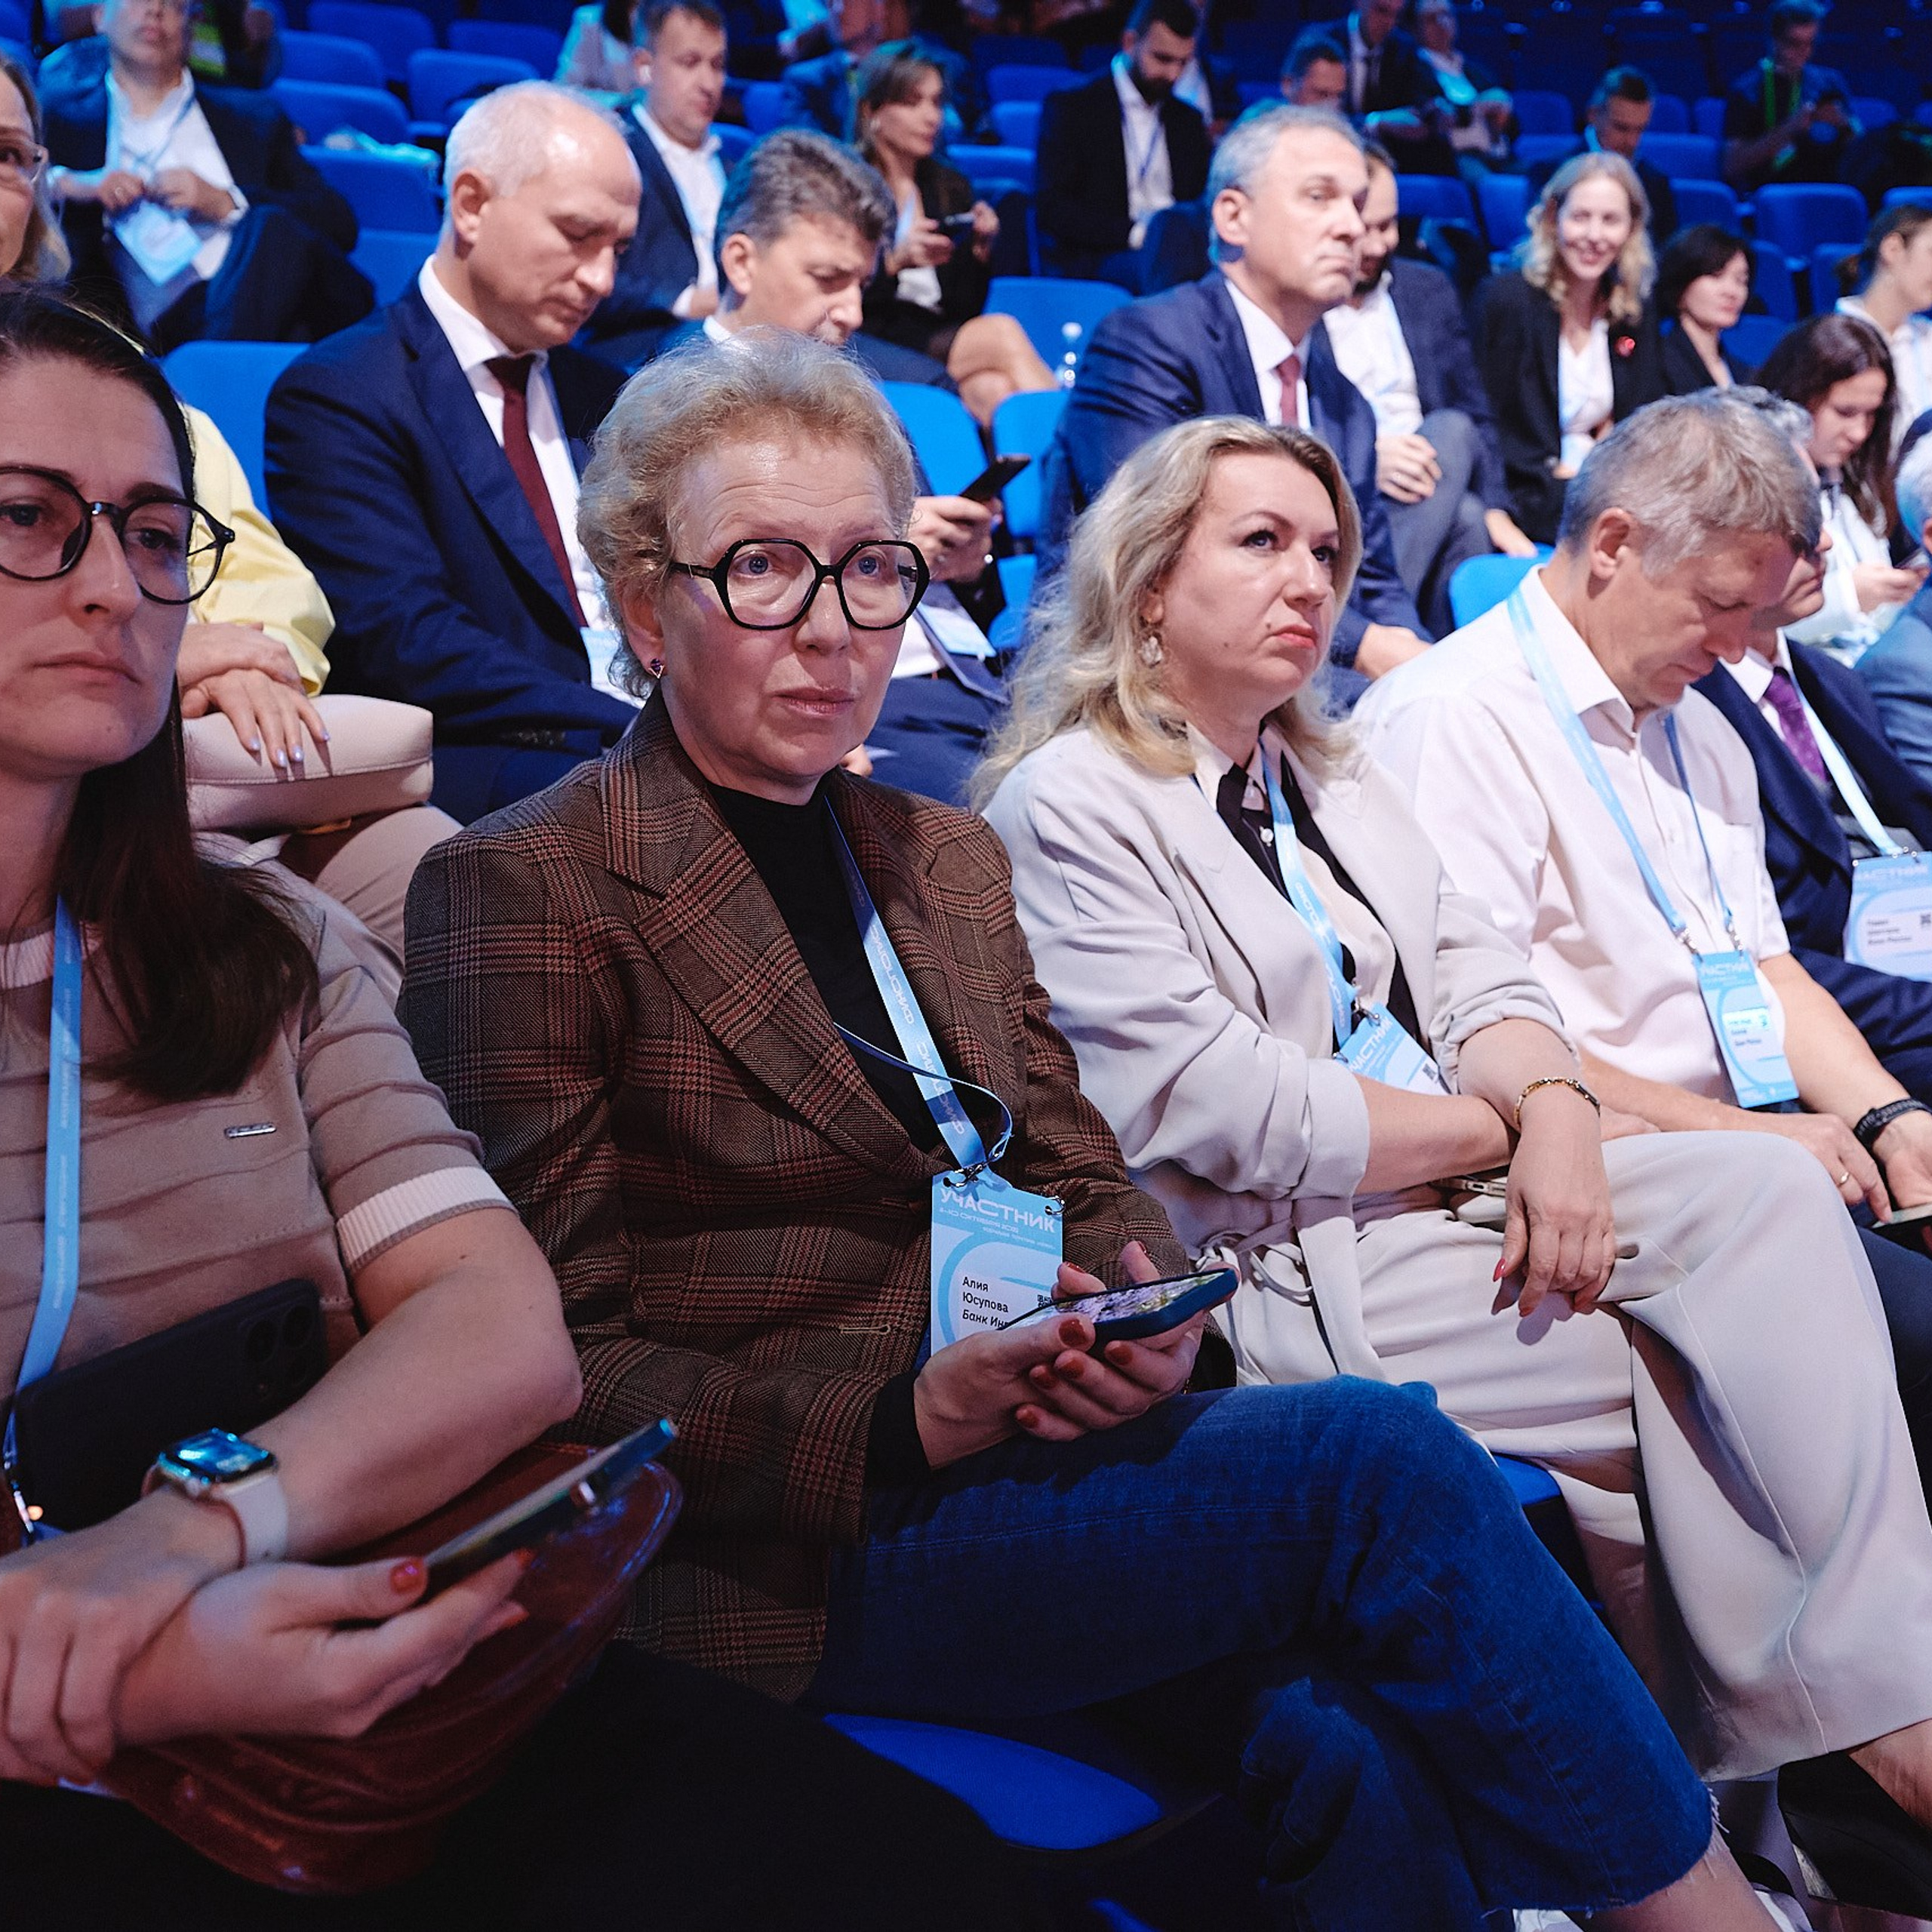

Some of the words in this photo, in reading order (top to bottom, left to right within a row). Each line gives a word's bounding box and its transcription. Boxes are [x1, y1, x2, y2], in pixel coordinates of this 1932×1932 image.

[869, 924, 915, 1024] ФИНОПОЛИС
[940, 1187, 1056, 1233] УЧАСТНИК
[962, 1276, 989, 1292] Алия
[962, 1291, 1009, 1313] Юсупова
[961, 1309, 988, 1325] Банк
